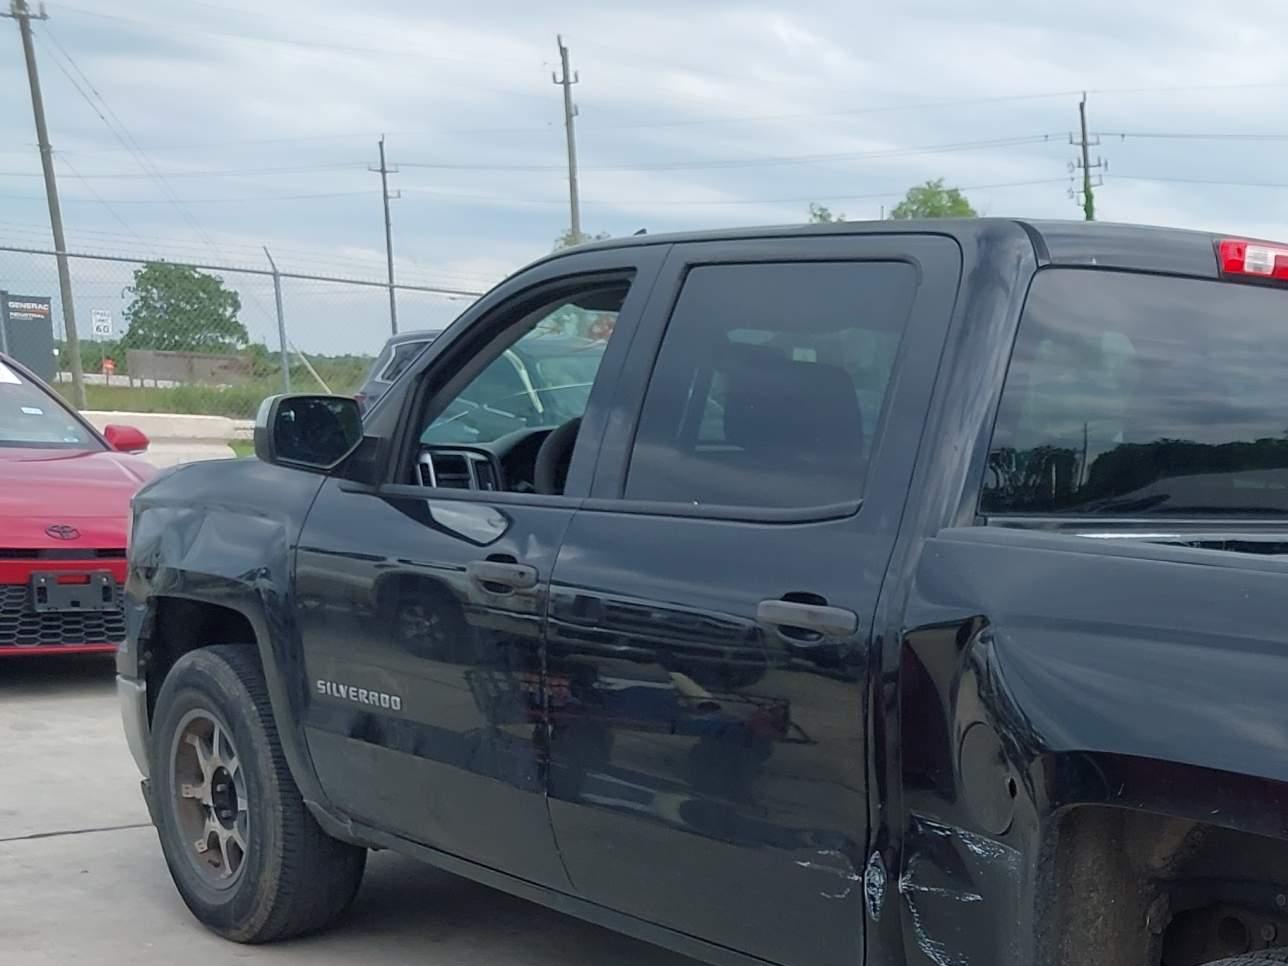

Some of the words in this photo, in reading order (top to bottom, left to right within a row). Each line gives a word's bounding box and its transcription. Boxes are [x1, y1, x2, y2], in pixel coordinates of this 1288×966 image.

[8, 301, 49, 311] GENERAC
[95, 324, 110, 334] 60
[316, 679, 401, 711] SILVERADO
